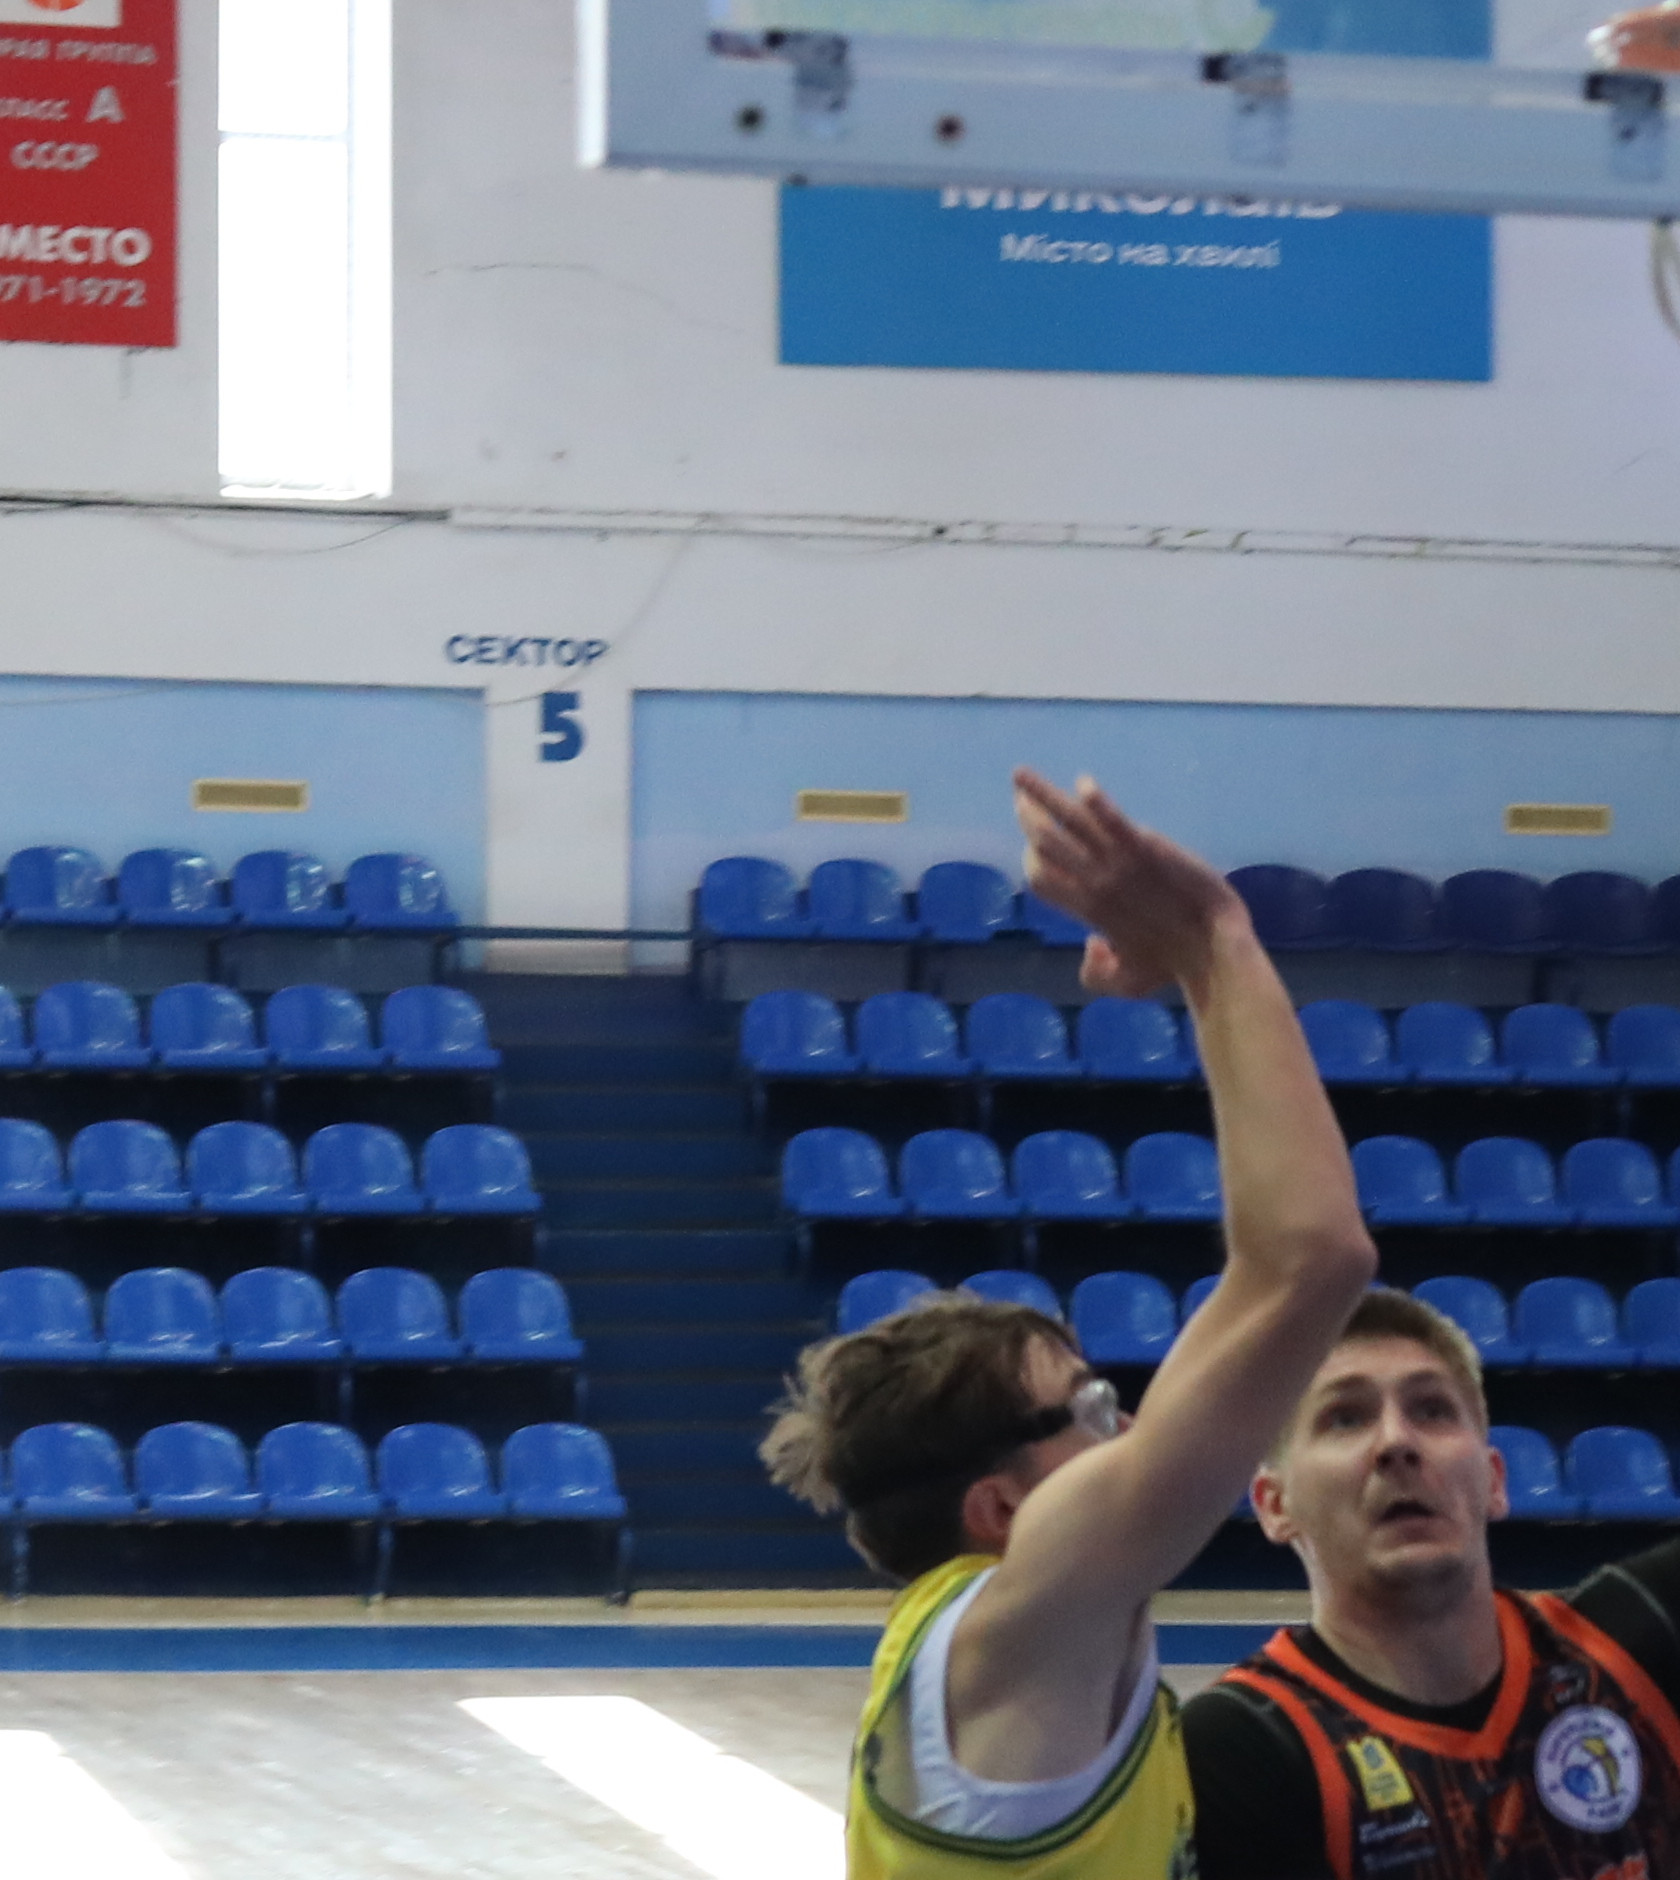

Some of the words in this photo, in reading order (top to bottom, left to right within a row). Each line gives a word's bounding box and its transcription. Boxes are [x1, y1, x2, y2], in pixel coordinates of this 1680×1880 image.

[10, 141, 100, 171] СССР
[444, 634, 610, 667] СЕКТОР
[537, 690, 584, 763] 5
